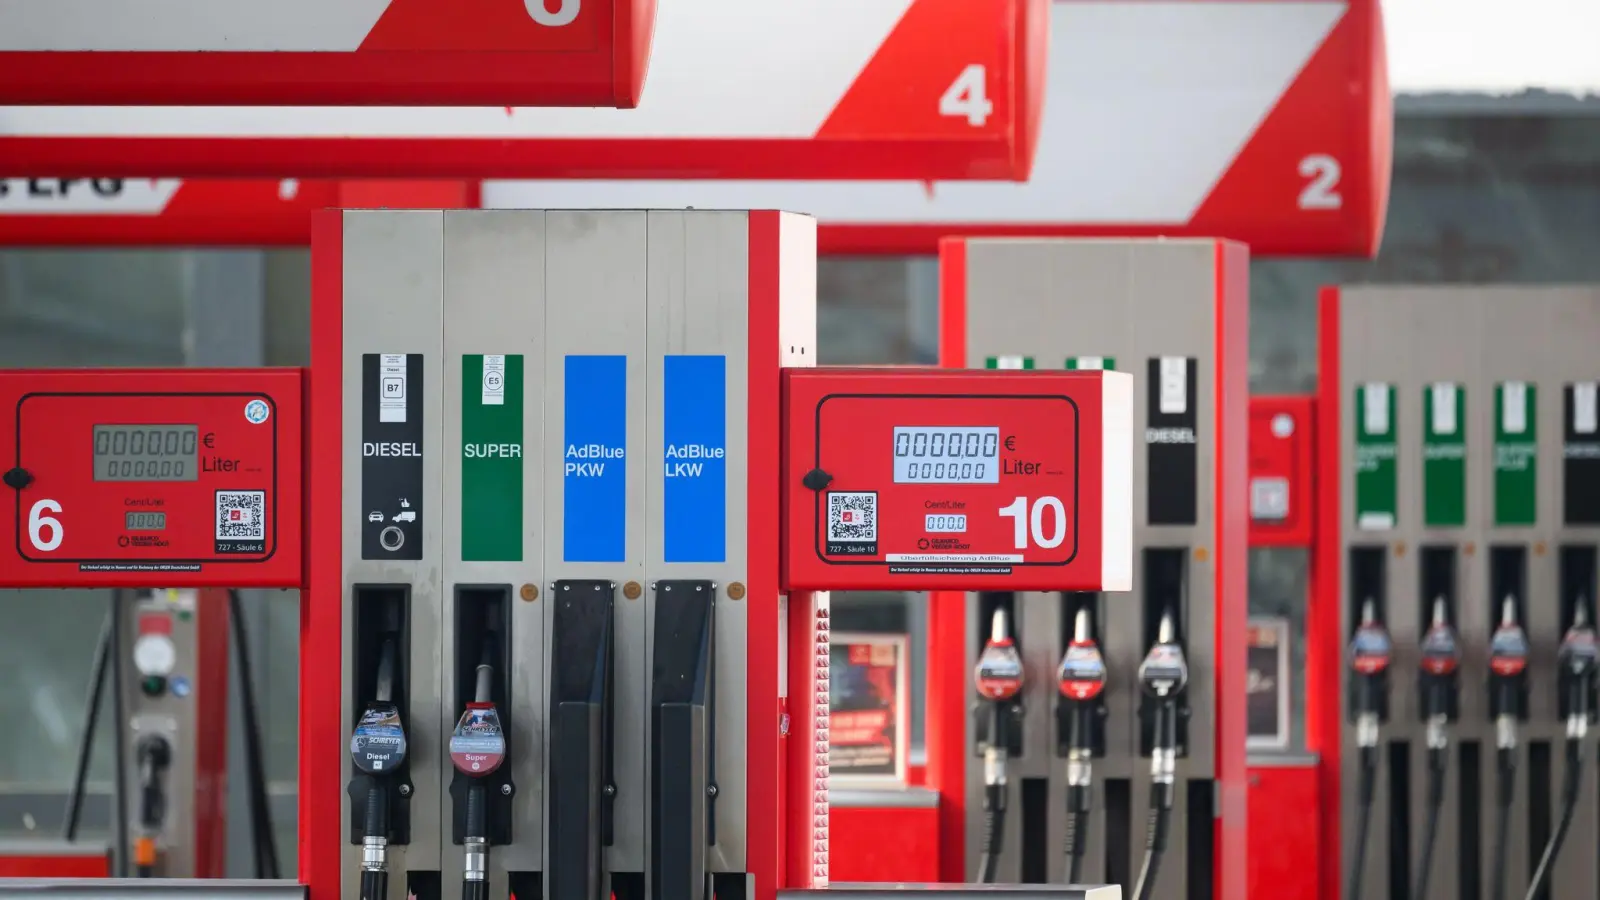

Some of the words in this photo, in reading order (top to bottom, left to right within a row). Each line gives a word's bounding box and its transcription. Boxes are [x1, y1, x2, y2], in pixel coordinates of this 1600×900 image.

[939, 64, 993, 127] 4
[1298, 153, 1342, 211] 2
[387, 384, 399, 392] B7
[488, 377, 500, 385] E5
[203, 432, 215, 449] €
[1146, 427, 1196, 443] DIESEL
[363, 442, 422, 457] DIESEL
[1004, 435, 1016, 451] €
[464, 444, 522, 458] SUPER
[566, 444, 625, 459] AdBlue
[665, 444, 725, 459] AdBlue
[202, 456, 240, 472] Liter
[565, 463, 605, 477] PKW
[665, 463, 703, 477] LKW
[1003, 459, 1042, 475] Liter
[924, 500, 966, 509] Cent/Liter
[28, 498, 64, 552] 6
[998, 496, 1067, 549] 10
[218, 543, 231, 551] 727
[236, 543, 257, 551] Säule
[257, 543, 263, 551] 6
[830, 545, 842, 553] 727
[847, 545, 866, 553] Säule
[867, 545, 875, 553] 10
[368, 736, 400, 745] SCHREYER
[366, 752, 390, 760] Diesel
[465, 754, 487, 762] Super
